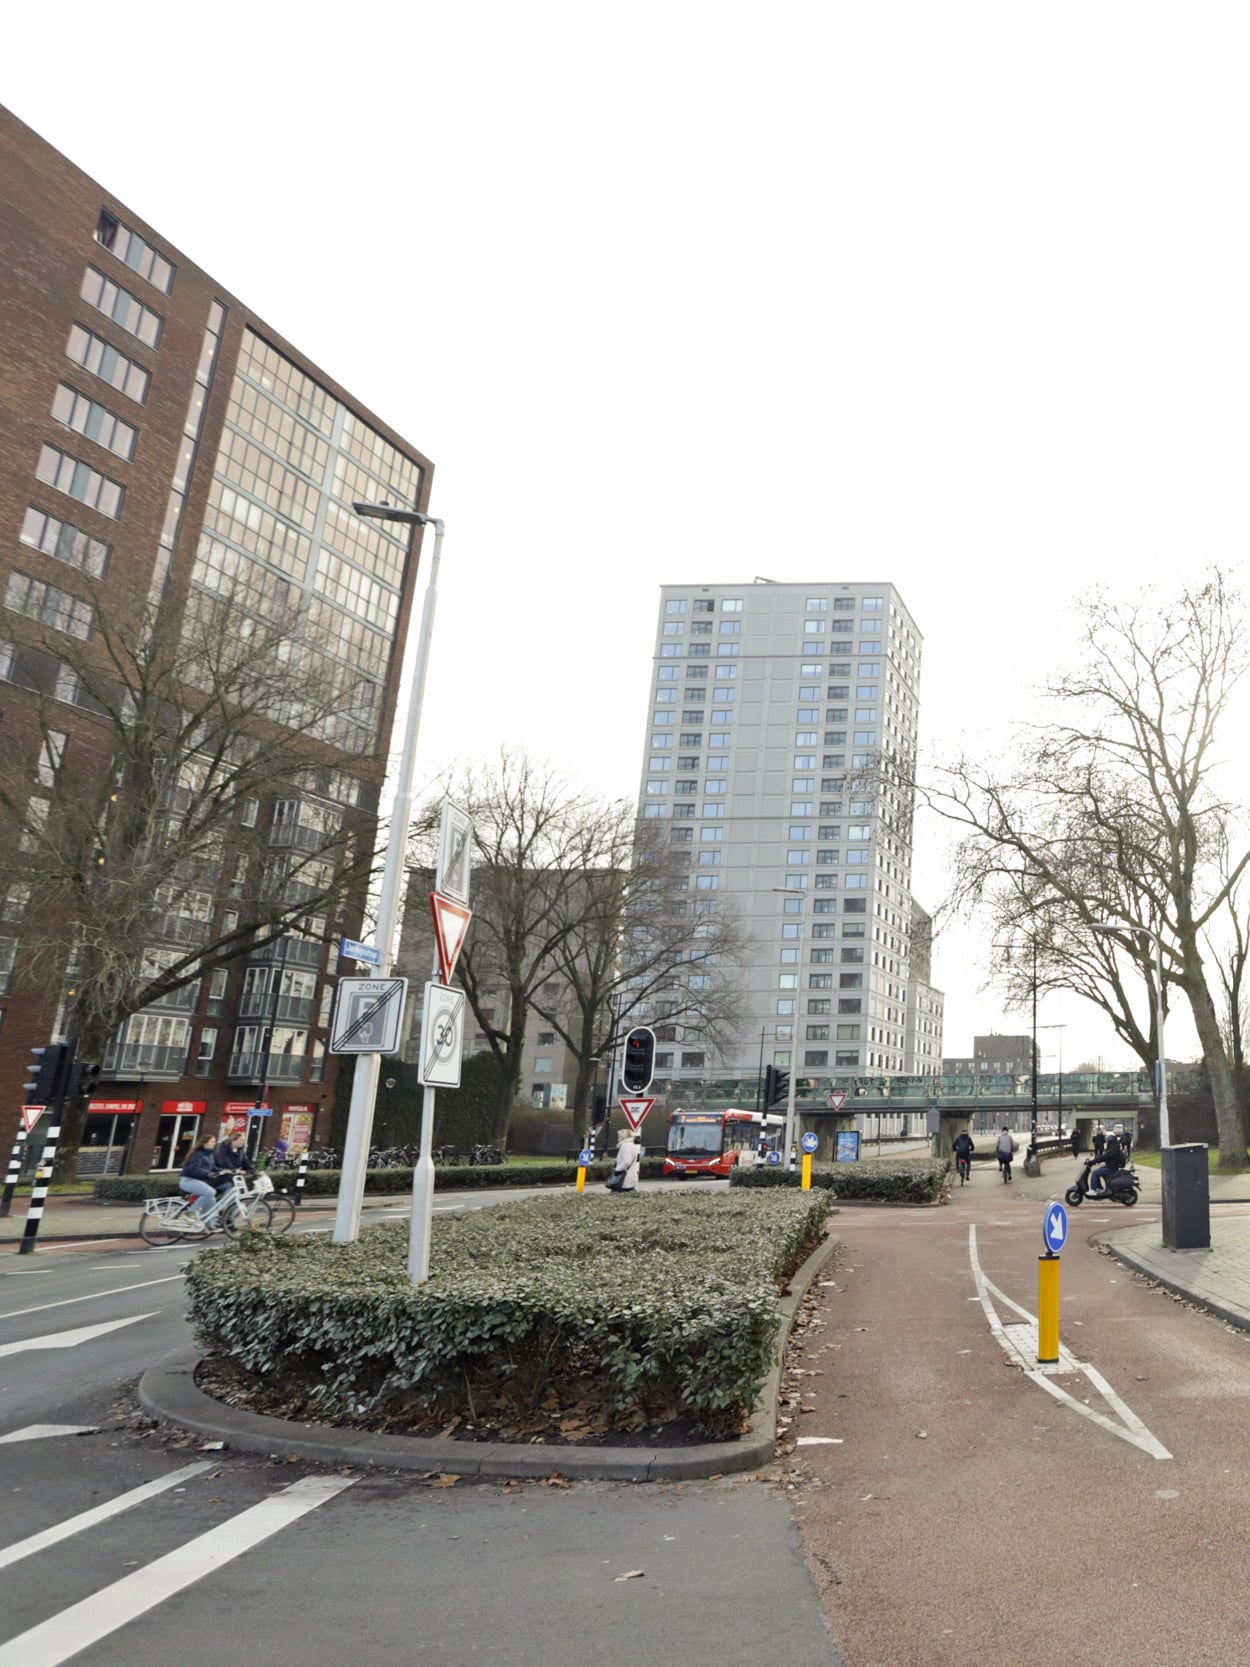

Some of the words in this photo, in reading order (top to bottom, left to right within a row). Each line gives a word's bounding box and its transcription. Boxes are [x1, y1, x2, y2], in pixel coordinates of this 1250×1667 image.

[358, 982, 387, 991] ZONE
[439, 991, 456, 1004] ZONE
[436, 1024, 454, 1047] 30
